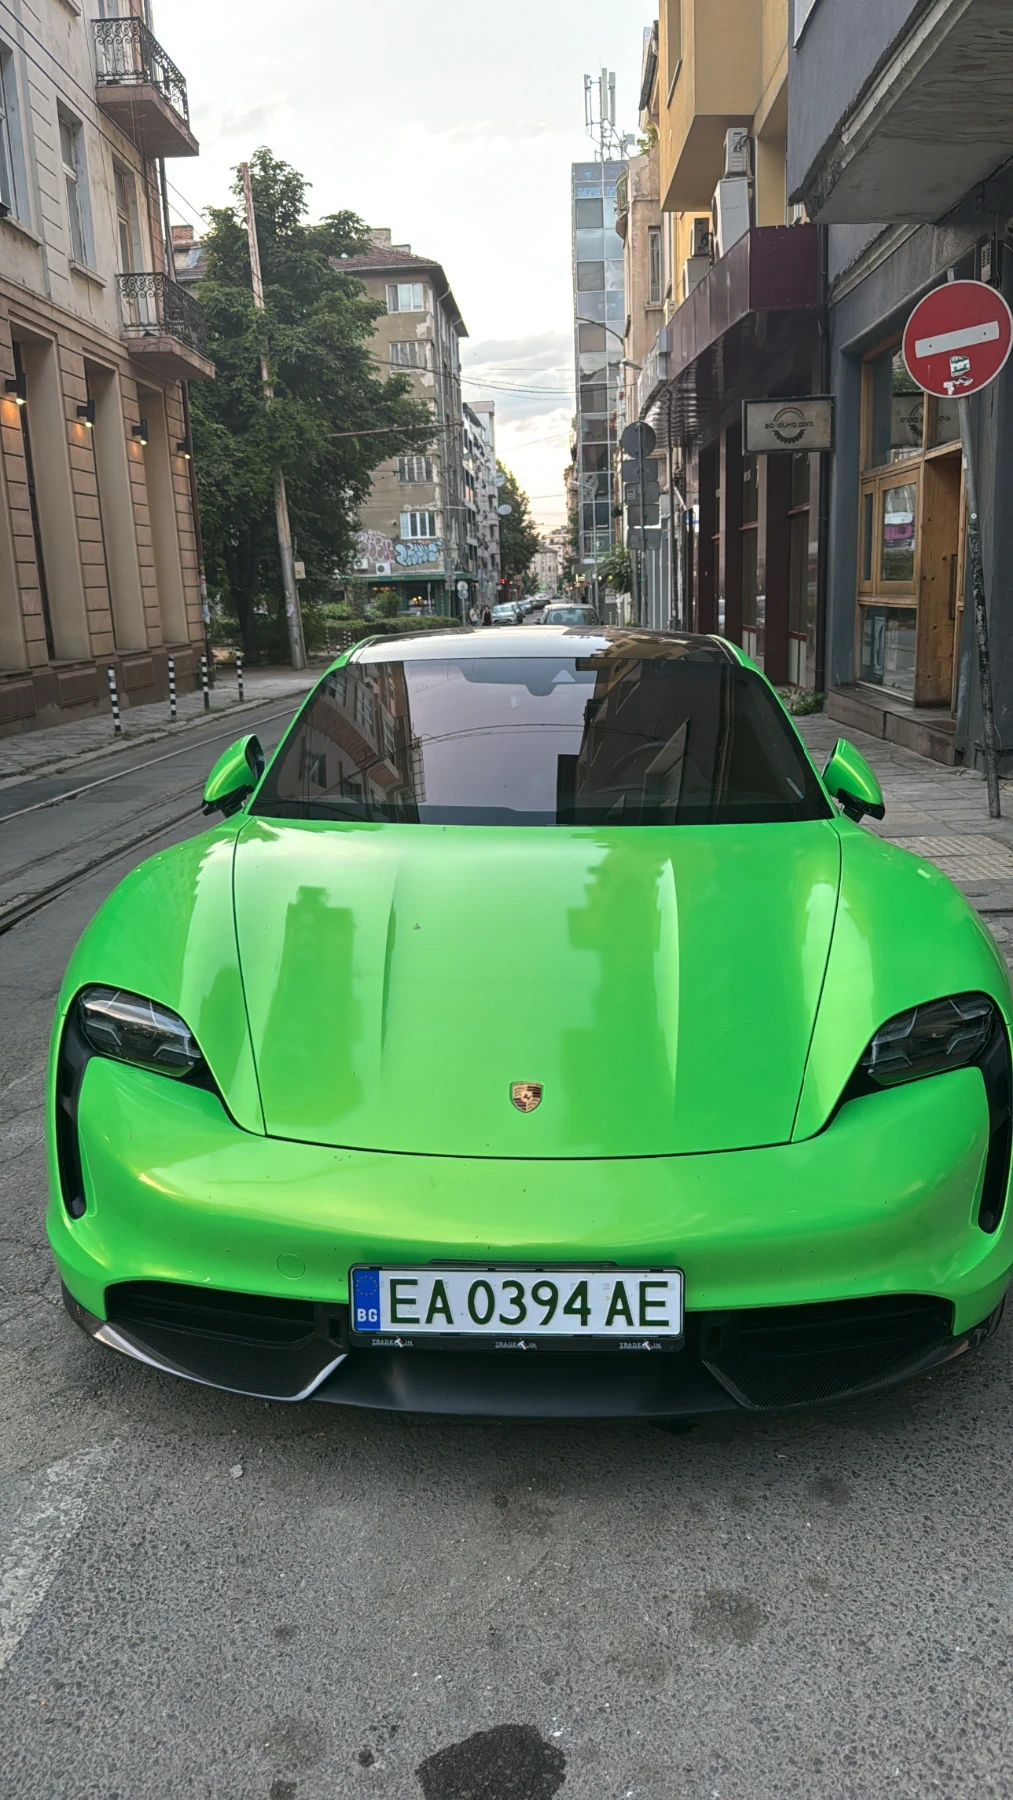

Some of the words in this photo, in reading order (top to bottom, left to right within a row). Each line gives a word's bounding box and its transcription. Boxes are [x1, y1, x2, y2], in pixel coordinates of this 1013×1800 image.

[357, 1308, 378, 1322] BG
[389, 1277, 454, 1325] EA
[467, 1278, 591, 1327] 0394
[604, 1279, 670, 1327] AE
